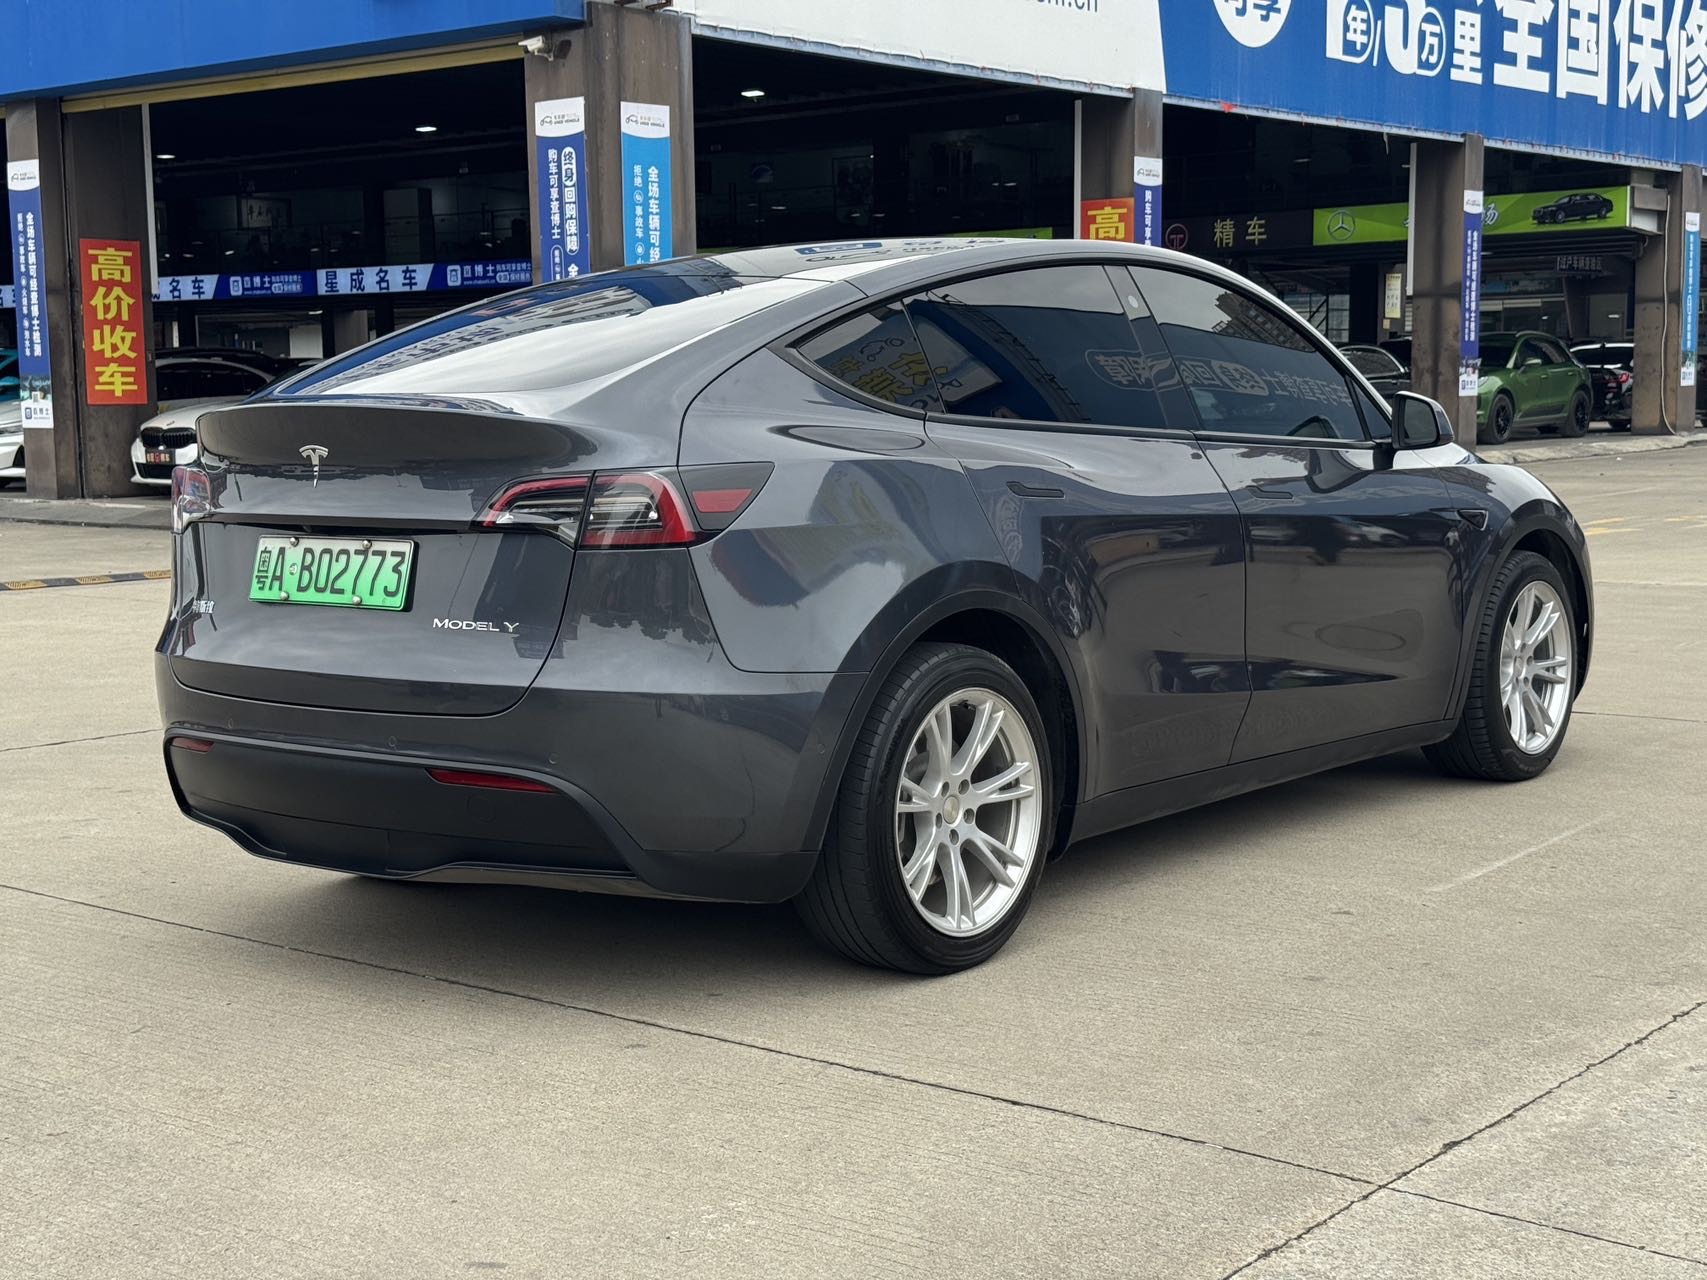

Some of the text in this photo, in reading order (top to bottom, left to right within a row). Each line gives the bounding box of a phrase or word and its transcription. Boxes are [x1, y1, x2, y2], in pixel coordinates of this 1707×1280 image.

[548, 148, 561, 239] 购车可享查博士
[562, 150, 578, 252] 终身回购保障
[1087, 206, 1127, 242] 高
[1214, 216, 1267, 248] 精车
[324, 266, 418, 293] 星成名车
[88, 247, 138, 398] 高价收车
[432, 618, 520, 633] MODEL Y
